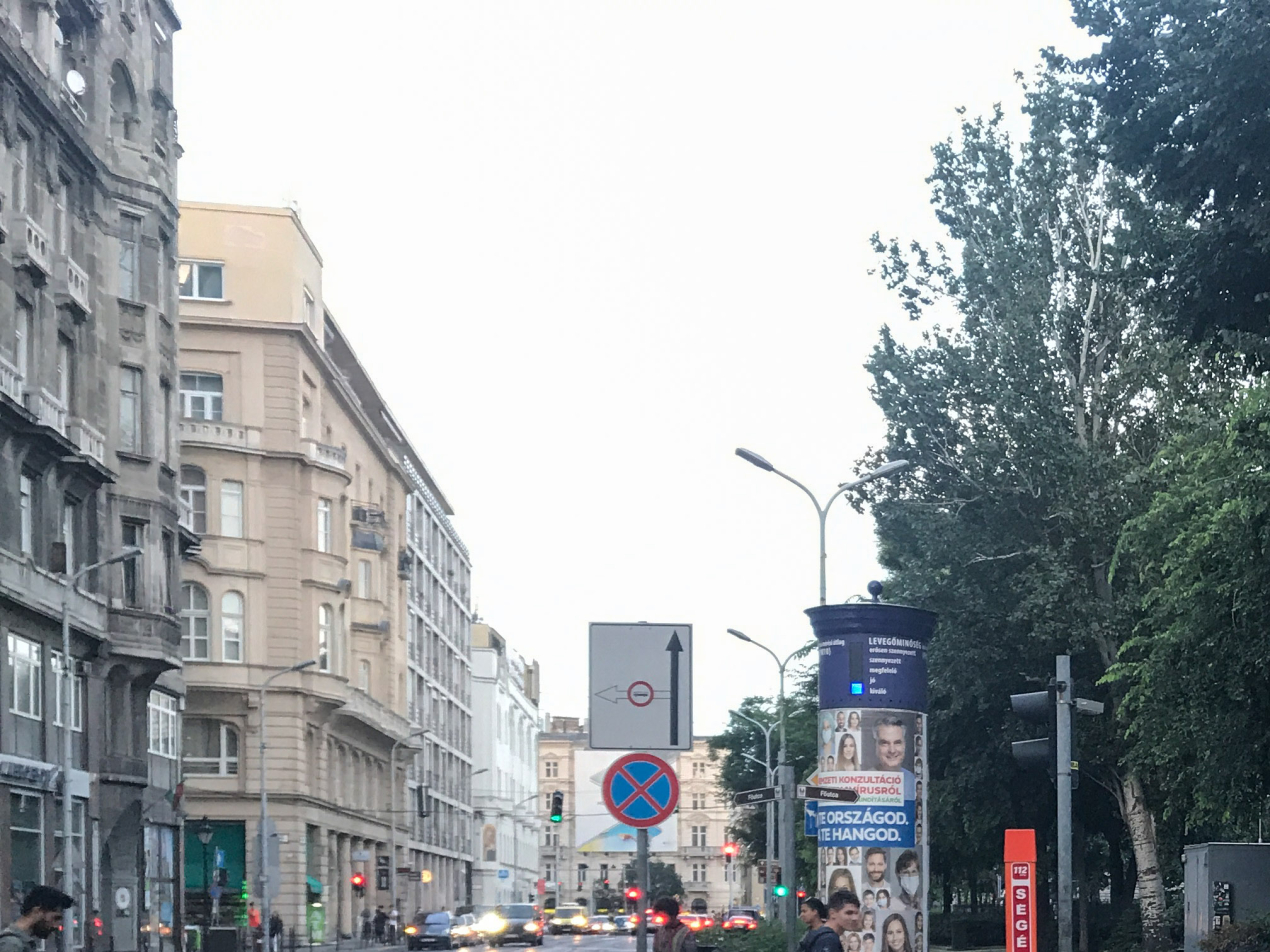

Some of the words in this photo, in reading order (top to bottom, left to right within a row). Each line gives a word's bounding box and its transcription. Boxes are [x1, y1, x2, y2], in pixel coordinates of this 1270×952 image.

[838, 775, 902, 785] KONZULTÁCIÓ
[827, 807, 909, 826] ORSZÁGOD.
[832, 827, 902, 842] HANGOD.
[1013, 866, 1028, 875] 112
